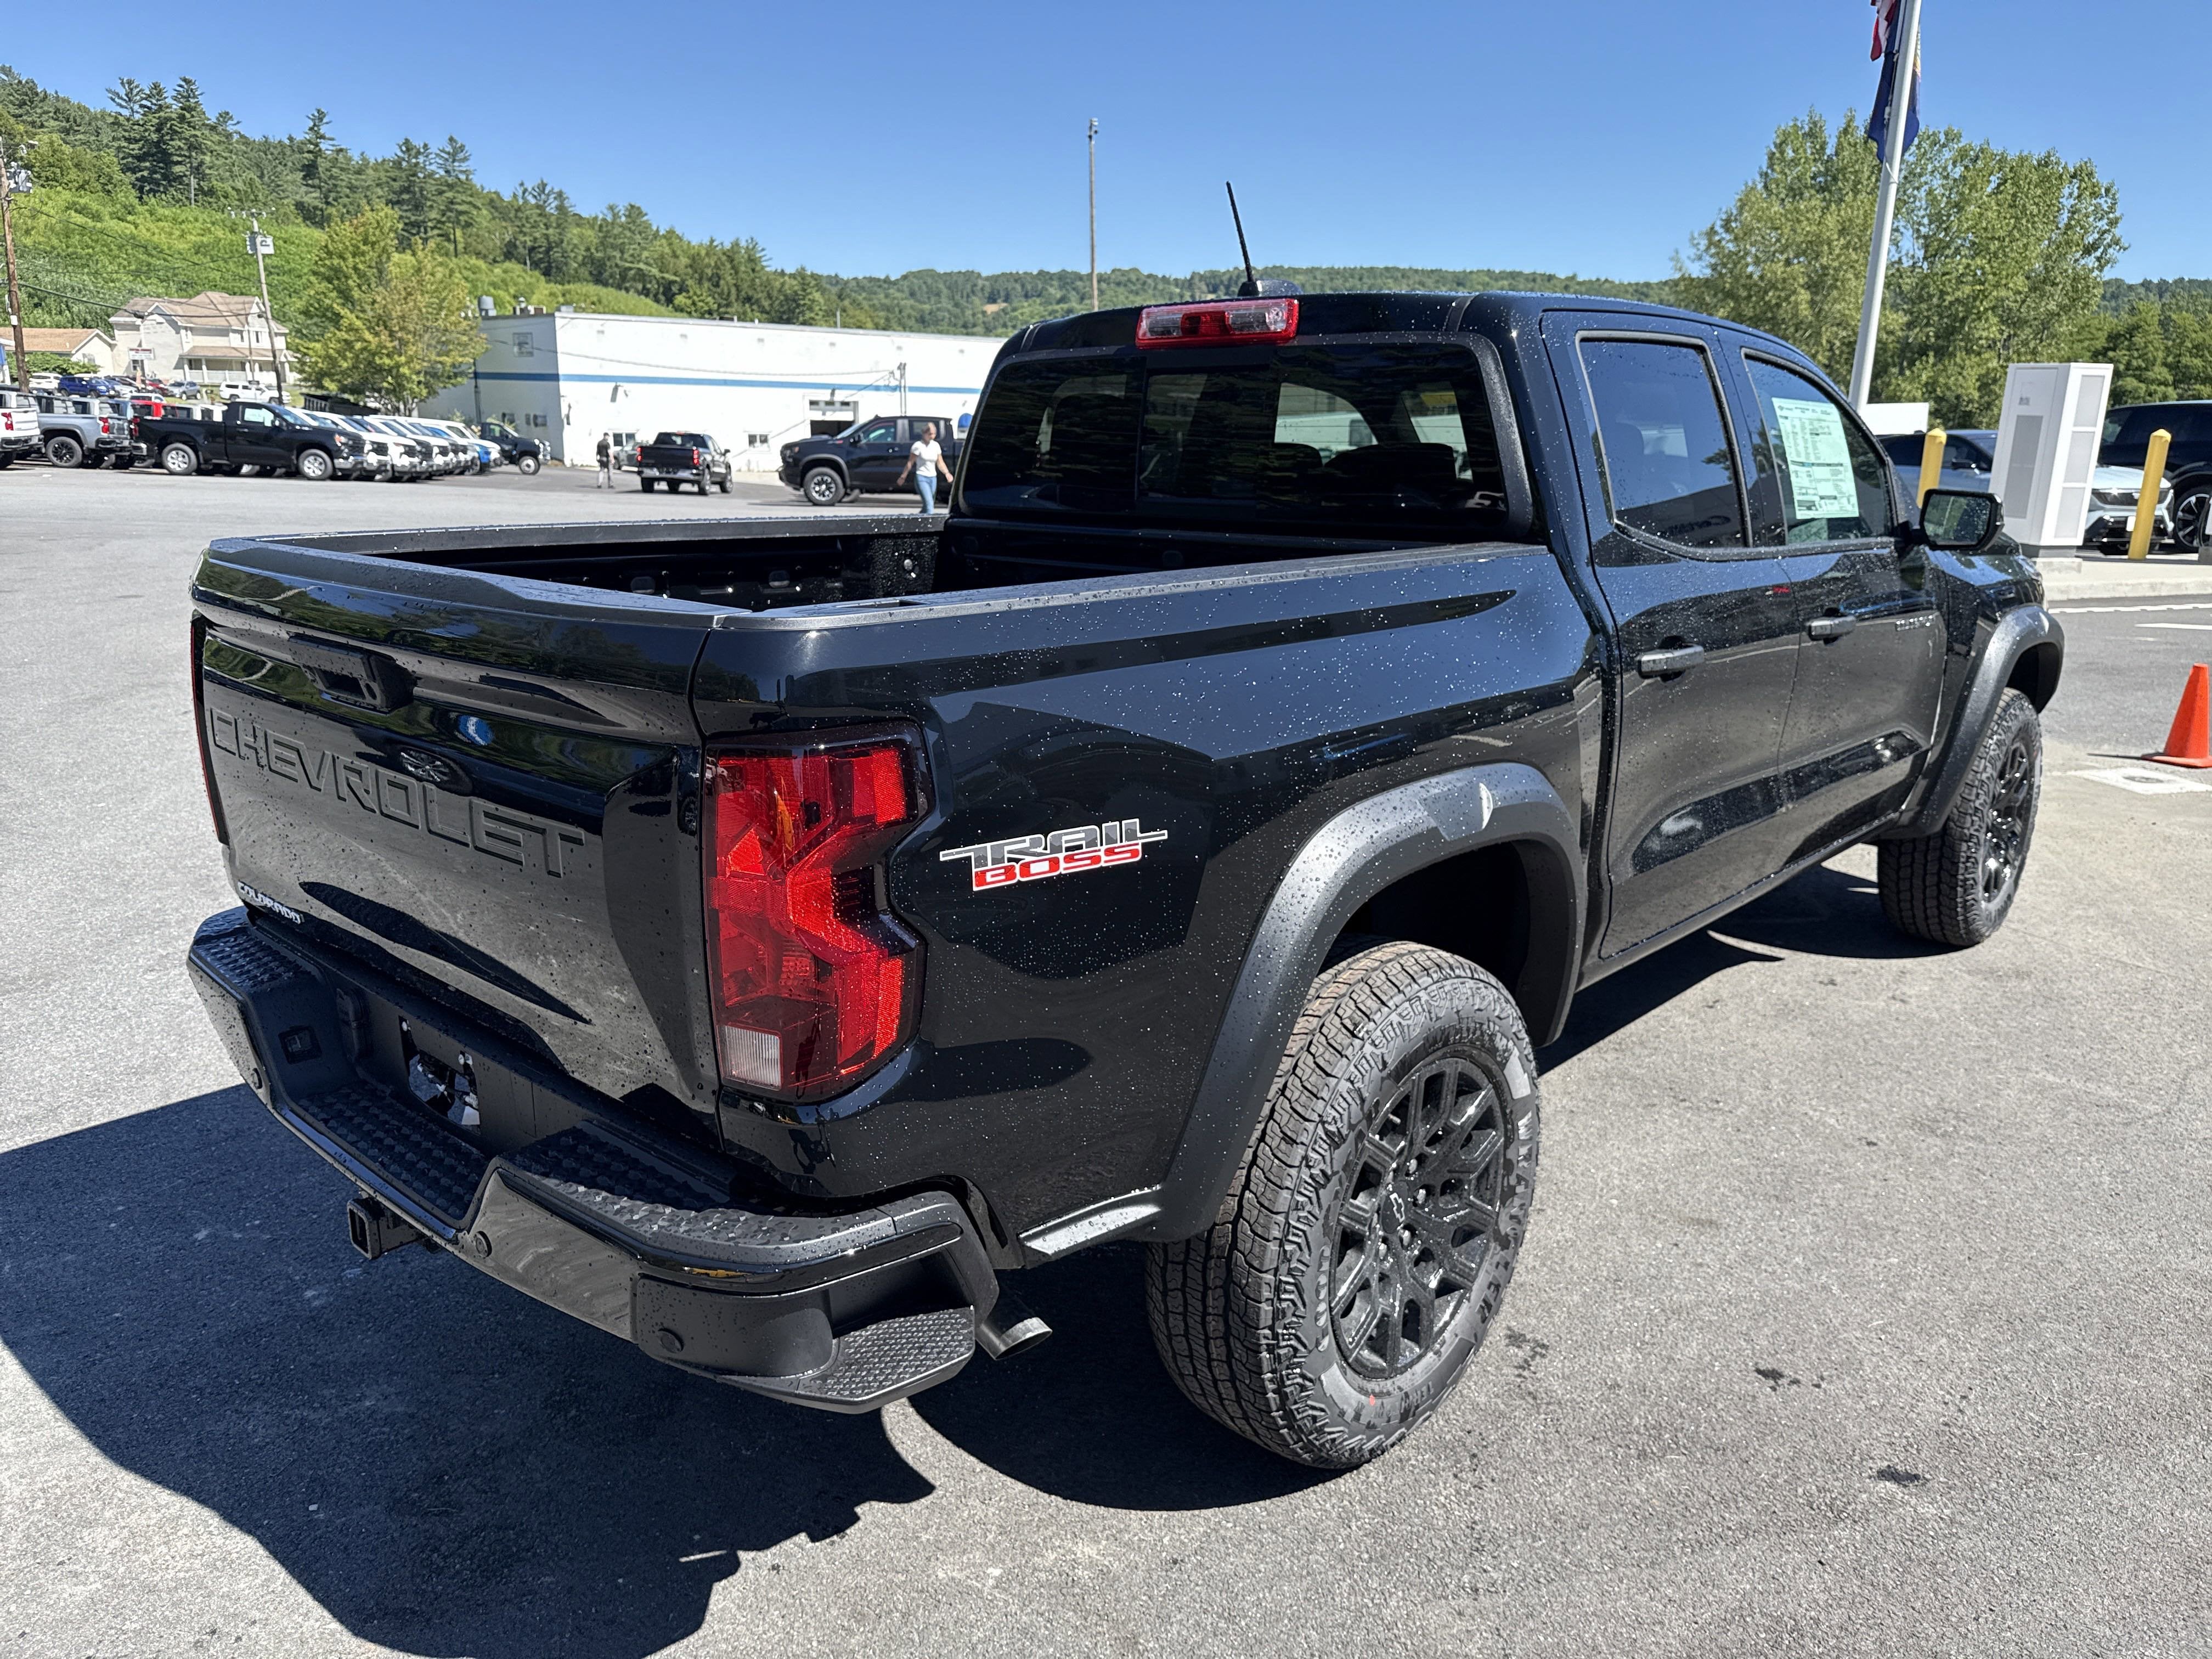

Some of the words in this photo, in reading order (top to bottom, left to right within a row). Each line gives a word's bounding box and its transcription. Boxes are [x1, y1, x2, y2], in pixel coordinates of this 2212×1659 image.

[211, 708, 585, 878] CHEVROLET
[940, 819, 1167, 869] TRAIL
[973, 842, 1142, 891] BOSS
[238, 881, 302, 924] COLORADO
